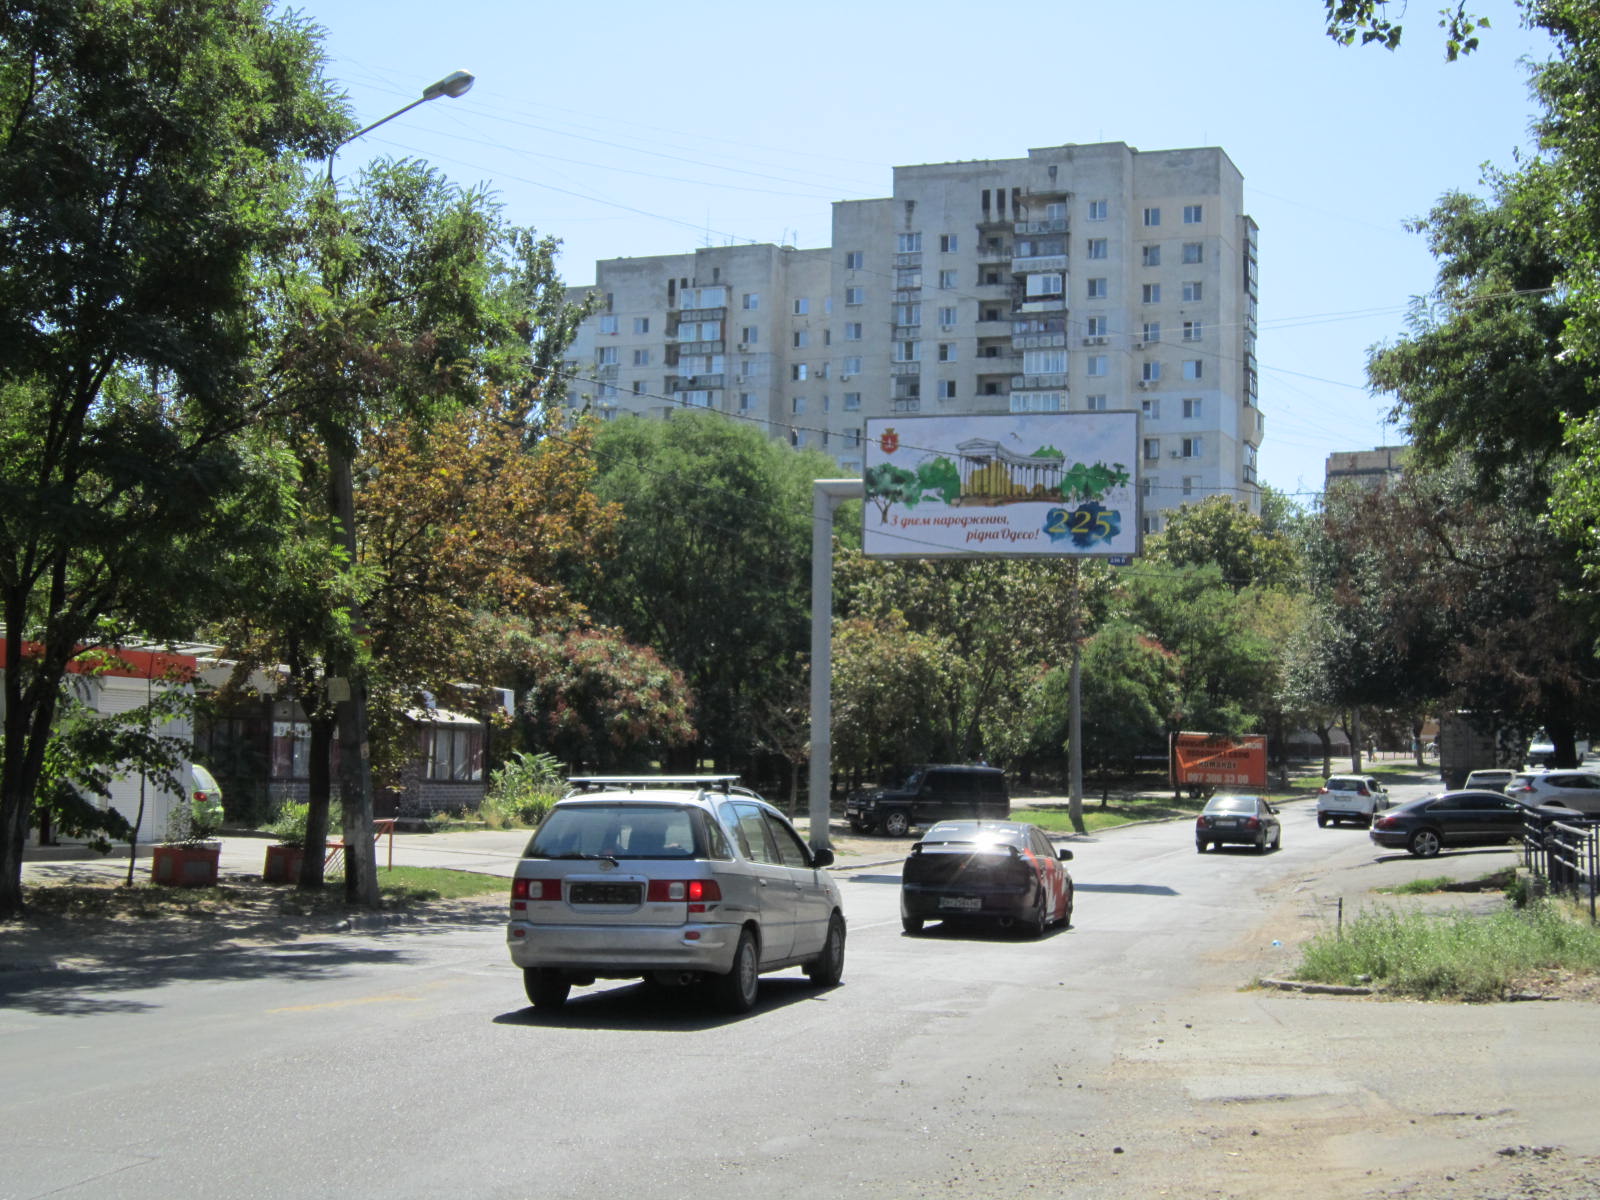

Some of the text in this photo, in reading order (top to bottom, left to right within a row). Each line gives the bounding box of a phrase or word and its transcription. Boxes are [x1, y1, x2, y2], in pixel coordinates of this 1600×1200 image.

[890, 514, 1009, 528] З днем народження,
[1048, 511, 1114, 538] 225
[965, 527, 1040, 543] рідна Одесо!
